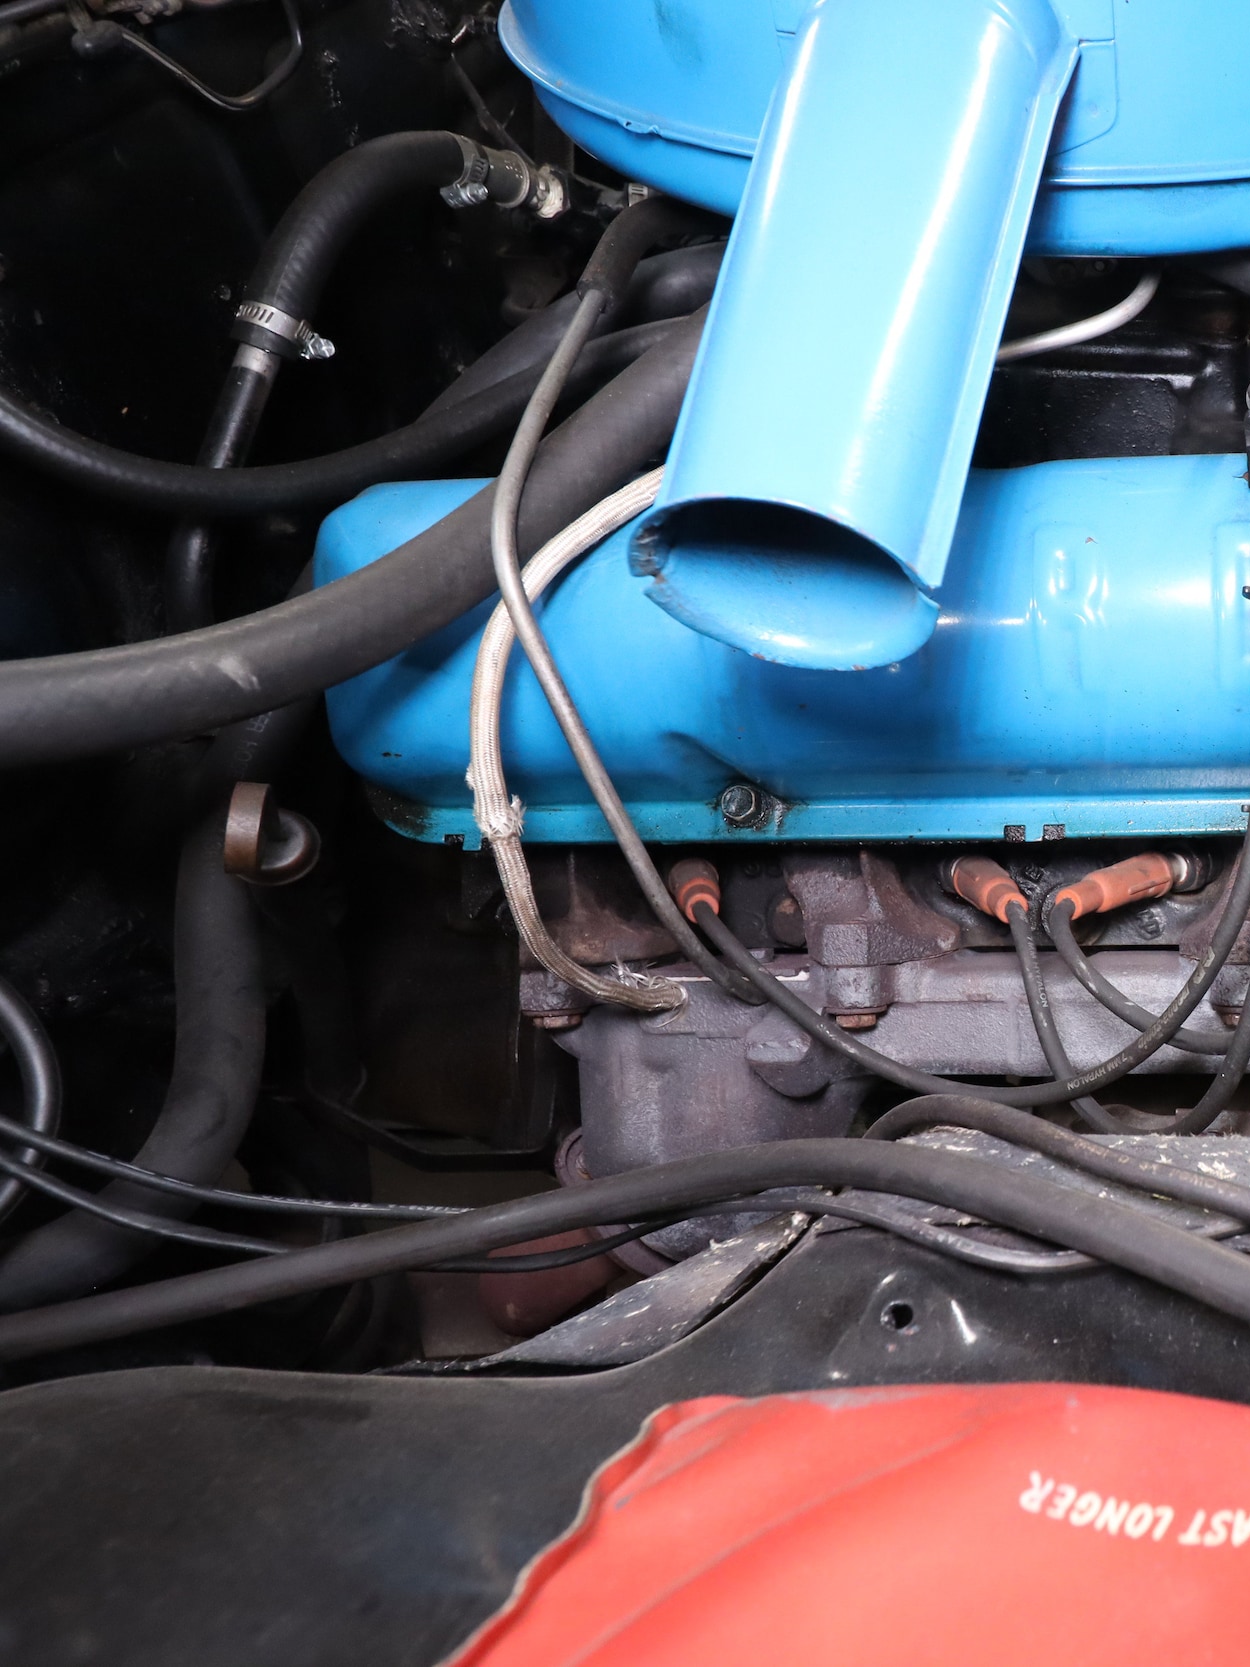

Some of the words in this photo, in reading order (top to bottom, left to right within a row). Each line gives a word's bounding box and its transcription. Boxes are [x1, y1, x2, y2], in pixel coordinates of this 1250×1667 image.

[1032, 961, 1049, 1009] HYPALON
[1066, 1067, 1107, 1091] HYPALON
[1106, 1051, 1129, 1074] 7MM
[1018, 1469, 1175, 1541] LONGER
